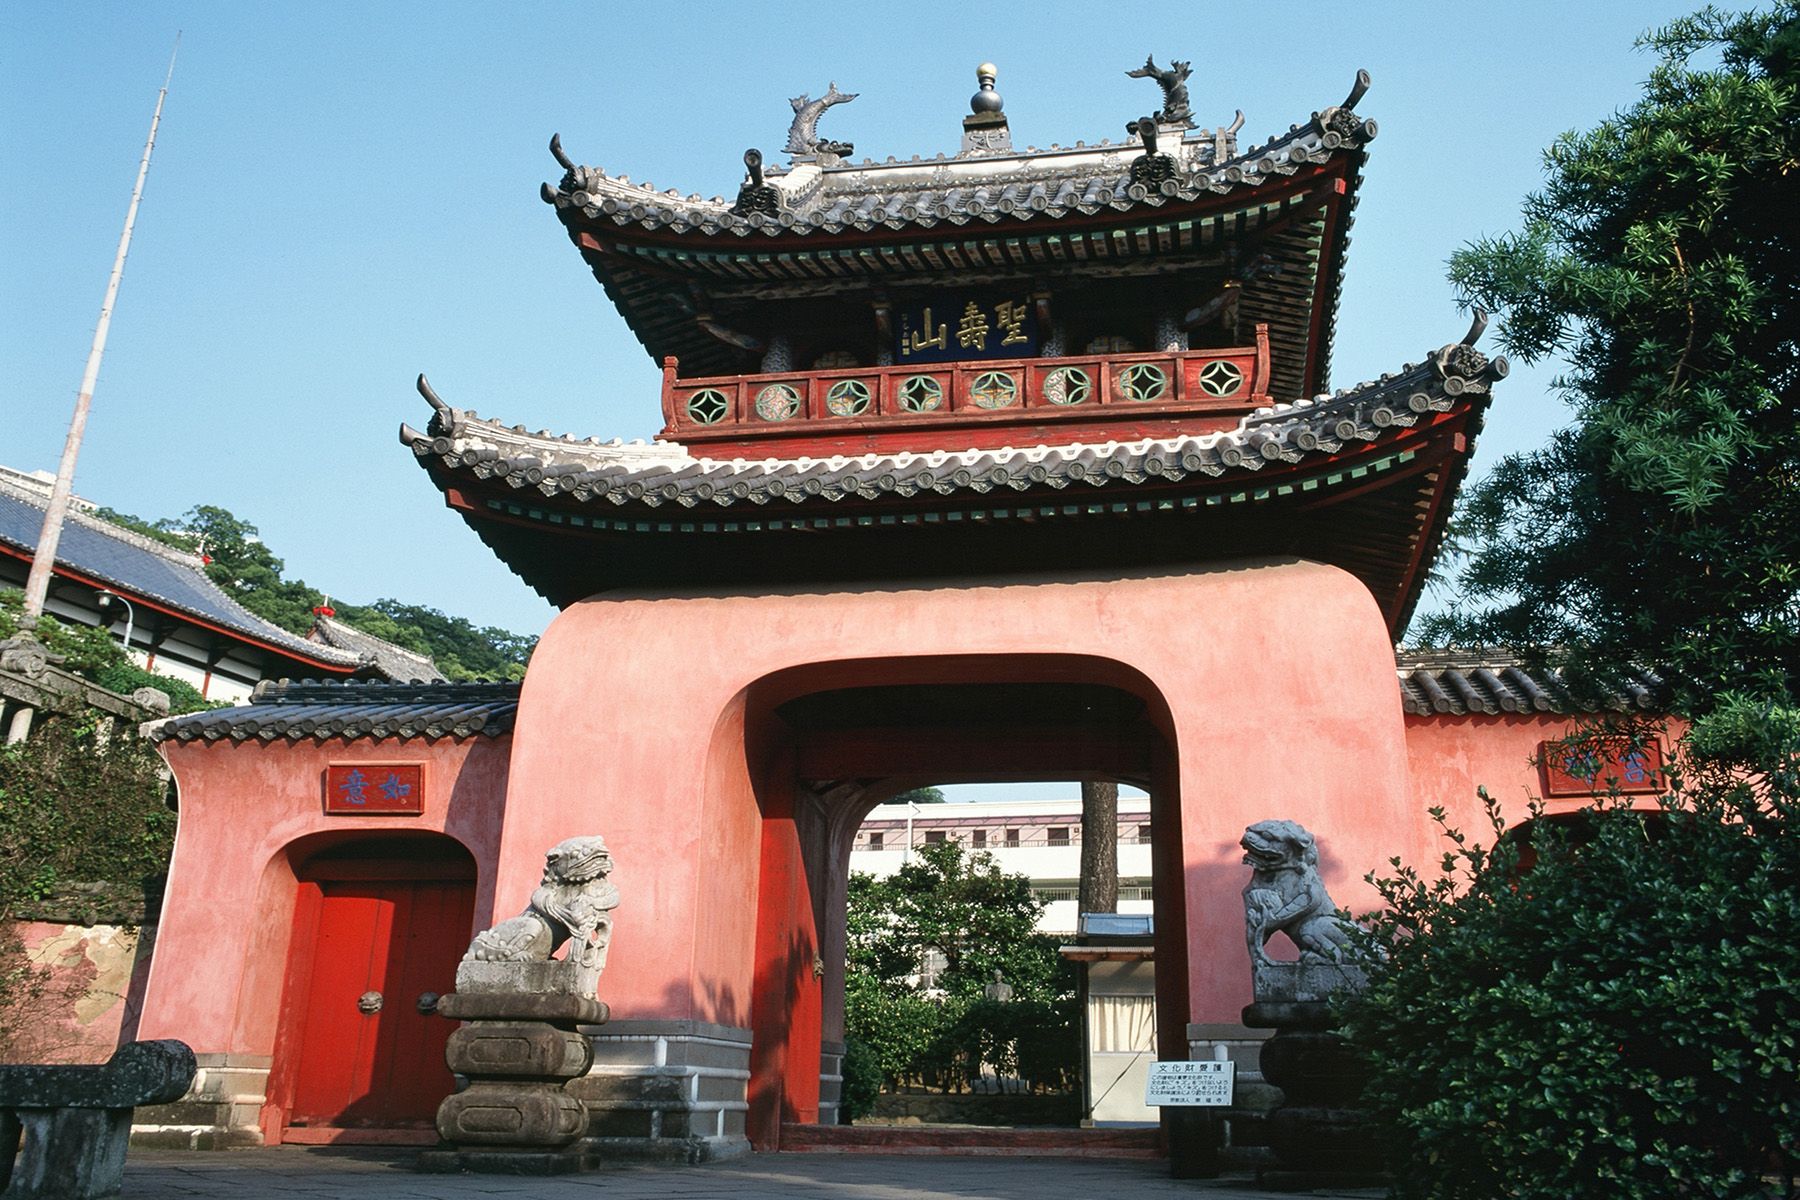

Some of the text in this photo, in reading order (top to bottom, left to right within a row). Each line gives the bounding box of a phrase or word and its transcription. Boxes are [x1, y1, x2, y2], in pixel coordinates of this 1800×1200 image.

[1158, 1063, 1222, 1073] 文化財愛護
